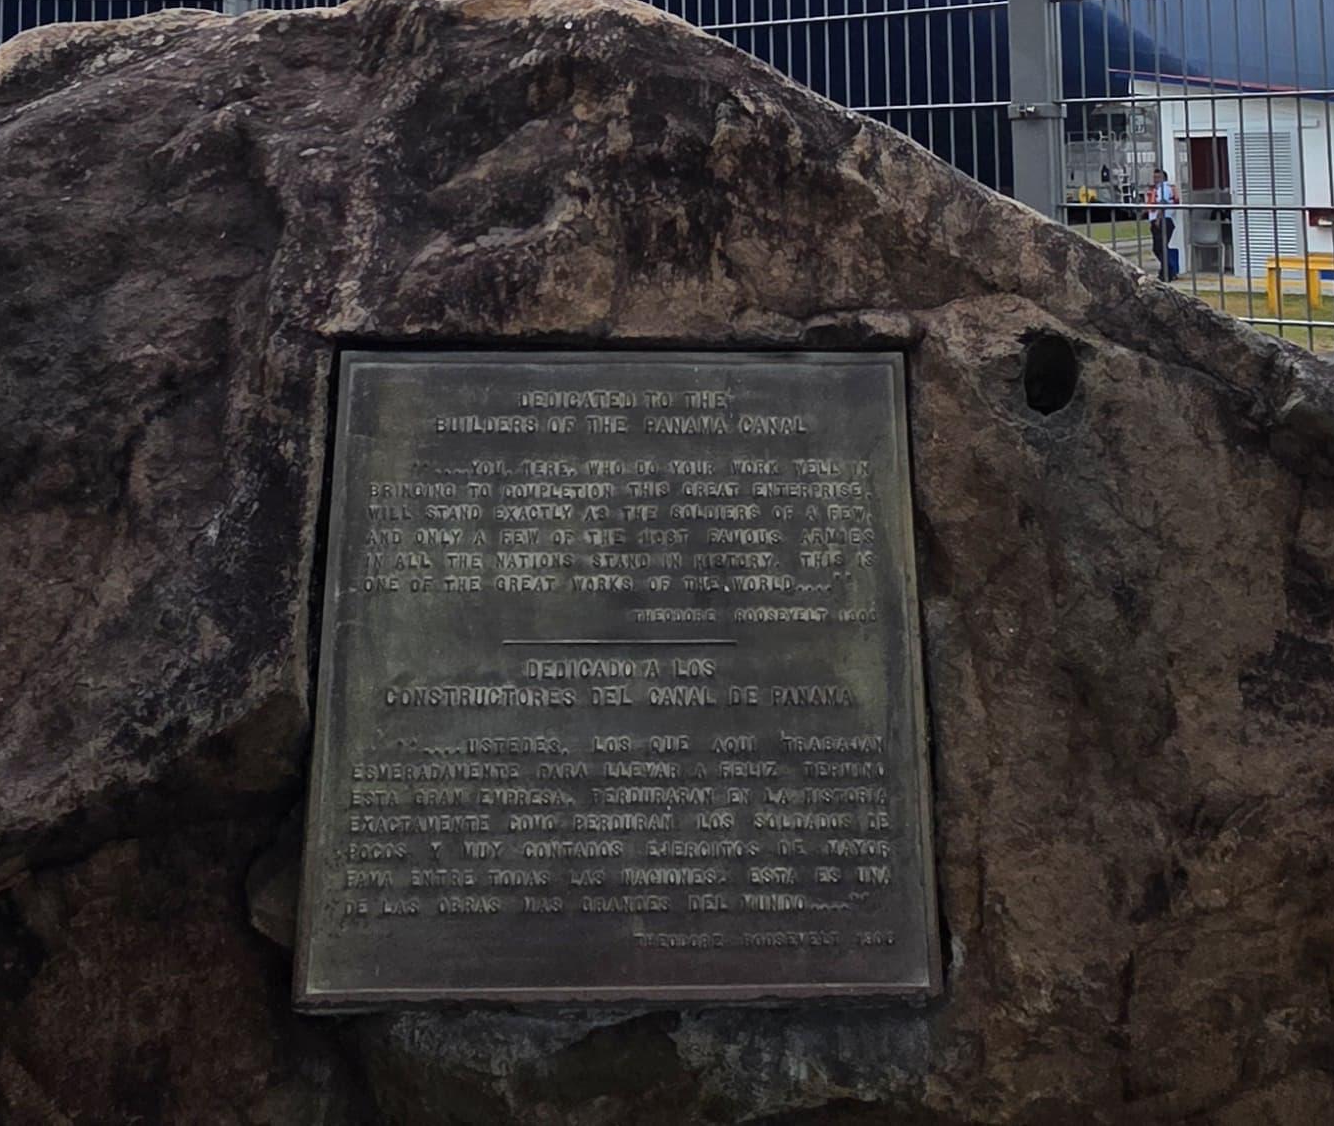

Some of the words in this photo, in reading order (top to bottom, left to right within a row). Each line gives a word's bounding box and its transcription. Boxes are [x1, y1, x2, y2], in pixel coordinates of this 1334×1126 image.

[519, 390, 637, 410] DEDICATED
[644, 391, 673, 411] TO
[685, 391, 728, 411] THE
[435, 416, 539, 434] BUILDERS
[548, 416, 578, 434] OF
[587, 416, 629, 434] THE
[644, 417, 729, 435] PANAMA
[739, 417, 808, 435] CANAL
[586, 459, 625, 476] WHO
[636, 459, 659, 476] DO
[670, 459, 716, 476] YOUR
[732, 459, 780, 476] WORK
[793, 459, 841, 476] WELL
[369, 482, 457, 500] BRINGING
[468, 482, 492, 500] TO
[503, 482, 615, 500] COMPLETION
[627, 482, 670, 500] THIS
[683, 482, 740, 500] GREAT
[367, 504, 413, 522] WILL
[425, 504, 483, 522] STAND
[495, 504, 573, 522] EXACTLY
[584, 504, 610, 522] AS
[621, 504, 659, 522] THE
[670, 504, 761, 522] SOLDIERS
[772, 504, 795, 522] OF
[805, 504, 820, 522] A
[366, 528, 404, 546] AND
[415, 528, 464, 546] ONLY
[474, 528, 486, 546] A
[500, 528, 540, 546] FEW
[552, 528, 575, 546] OF
[584, 528, 626, 546] THE
[708, 528, 784, 546] FAMOUS
[800, 528, 876, 546] ARMIES
[366, 551, 384, 569] IN
[395, 551, 433, 569] ALL
[446, 551, 484, 569] THE
[496, 551, 575, 569] NATIONS
[591, 551, 651, 569] STAND
[663, 551, 683, 569] IN
[799, 551, 845, 569] THIS
[857, 551, 876, 569] IS
[363, 575, 400, 593] ONE
[410, 575, 433, 593] OF
[444, 575, 484, 593] THE
[495, 575, 557, 593] GREAT
[570, 575, 634, 593] WORKS
[648, 575, 671, 593] OF
[633, 607, 716, 623] THEODORE
[733, 607, 830, 623] ROOSEVELT
[526, 658, 637, 679] DEDICADO
[645, 657, 660, 678] A
[673, 657, 716, 678] LOS
[384, 685, 577, 707] CONSTRUCTORES
[590, 685, 634, 707] DEL
[648, 685, 717, 707] CANAL
[730, 685, 760, 707] DE
[771, 685, 856, 707] PANAMA
[592, 737, 632, 755] LOS
[649, 736, 691, 754] QUE
[351, 761, 521, 781] ESMERADAMENTE
[537, 760, 589, 780] PARA
[694, 760, 708, 780] A
[719, 759, 779, 779] FELIZ
[350, 788, 400, 806] ESTA
[413, 788, 464, 806] GRAN
[726, 787, 751, 805] EN
[764, 787, 790, 805] LA
[803, 787, 888, 805] HISTORIA
[349, 813, 491, 833] EXACTAMENTE
[507, 812, 557, 832] COMO
[697, 812, 735, 832] LOS
[754, 811, 853, 831] SOLDADOS
[348, 841, 408, 859] POCOS
[430, 841, 444, 859] Y
[522, 841, 624, 859] CONTADOS
[646, 840, 760, 858] EJERCITOS
[347, 868, 395, 887] FAMA
[411, 868, 475, 887] ENTRE
[487, 867, 551, 886] TODAS
[569, 867, 606, 886] LAS
[346, 896, 369, 915] DE
[381, 896, 420, 915] LAS
[437, 896, 501, 915] OBRAS
[580, 895, 671, 914] GRANDES
[687, 895, 729, 914] DEL
